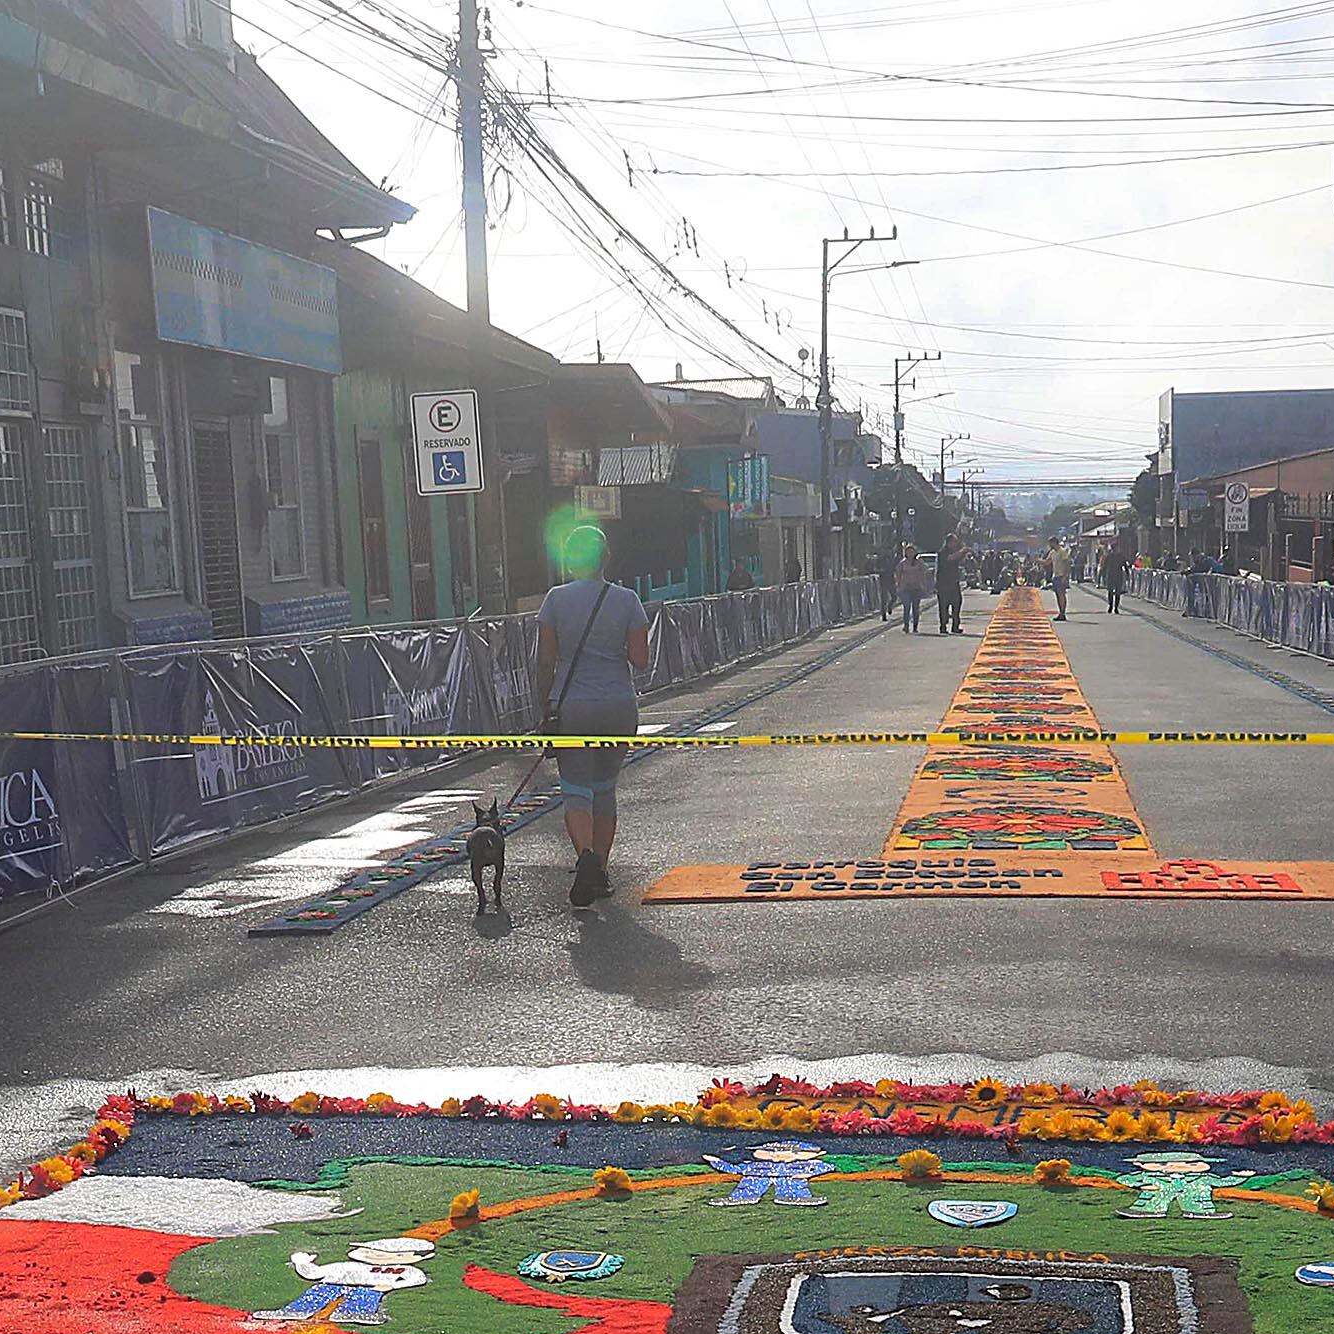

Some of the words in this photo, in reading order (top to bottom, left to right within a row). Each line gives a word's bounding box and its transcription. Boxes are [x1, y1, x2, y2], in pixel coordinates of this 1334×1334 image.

[437, 405, 454, 427] E
[423, 437, 471, 449] RESERVADO
[748, 857, 997, 871] Parroquia
[738, 869, 805, 881] San
[742, 880, 794, 893] El
